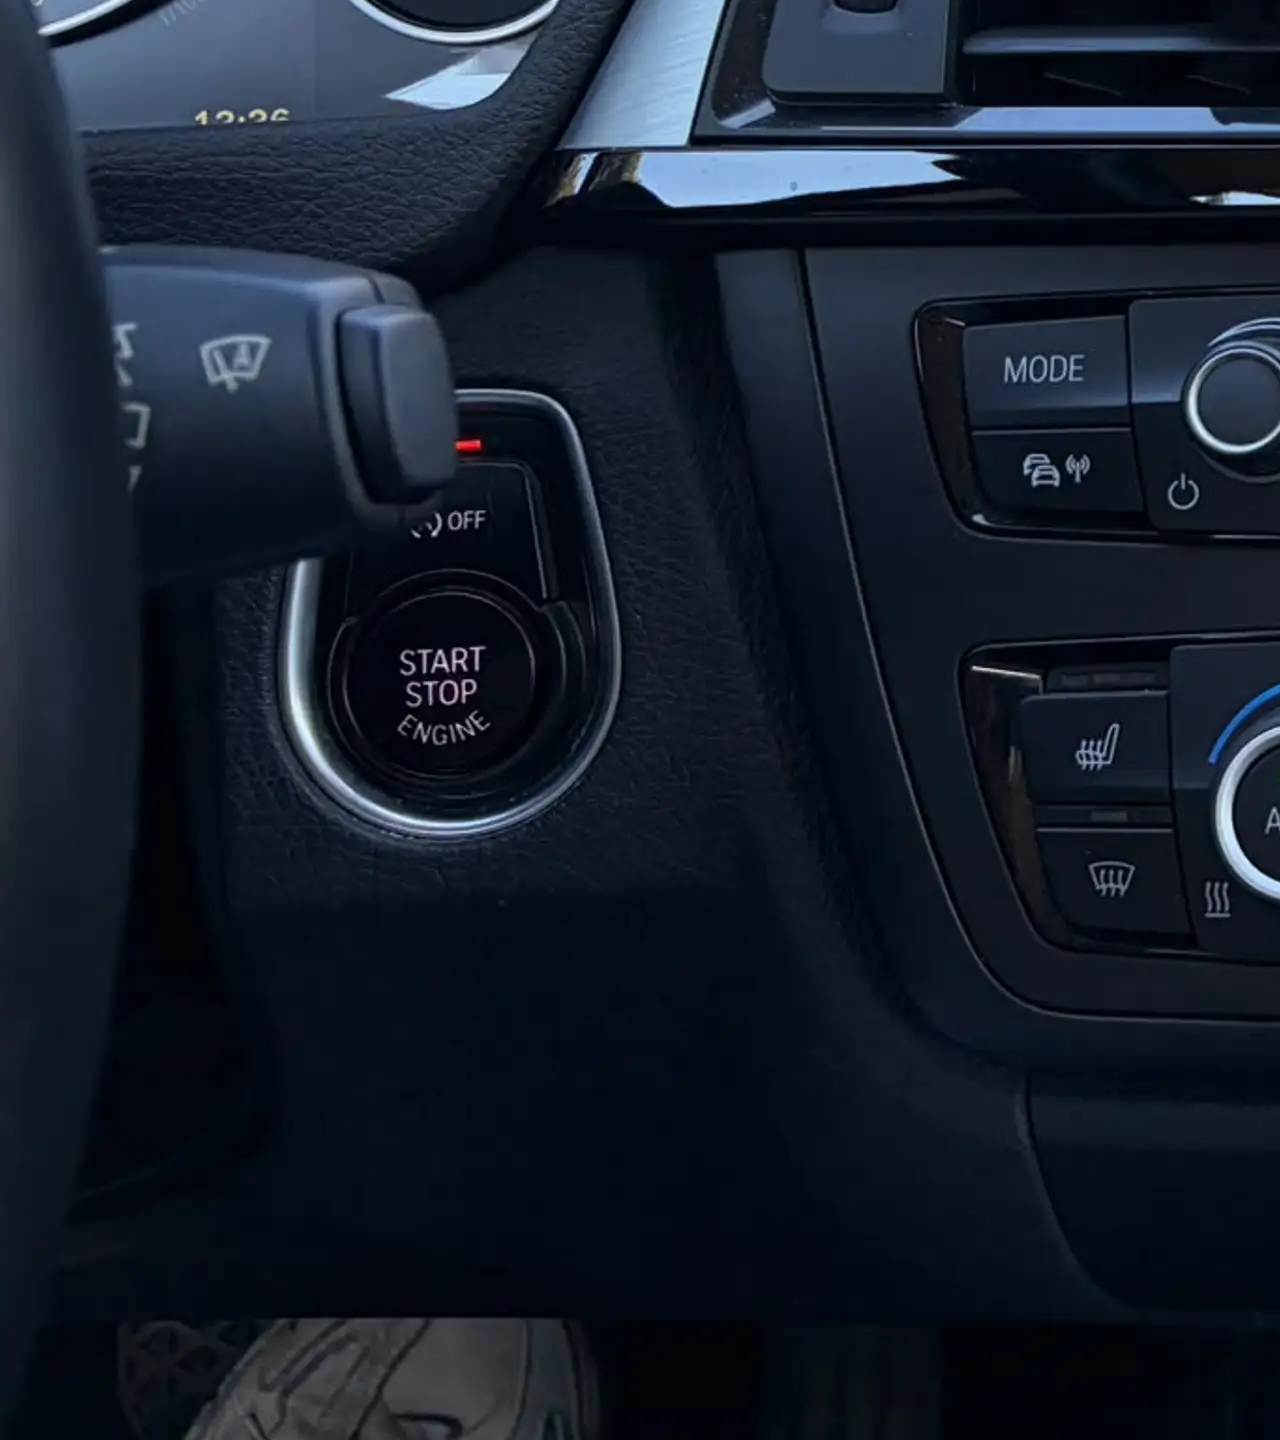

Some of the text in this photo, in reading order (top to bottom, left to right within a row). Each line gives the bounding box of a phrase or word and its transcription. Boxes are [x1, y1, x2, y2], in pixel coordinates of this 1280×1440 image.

[1003, 354, 1086, 385] MODE
[447, 509, 487, 531] OFF
[399, 644, 487, 677] START
[405, 677, 478, 708] STOP
[397, 709, 491, 746] ENGINE
